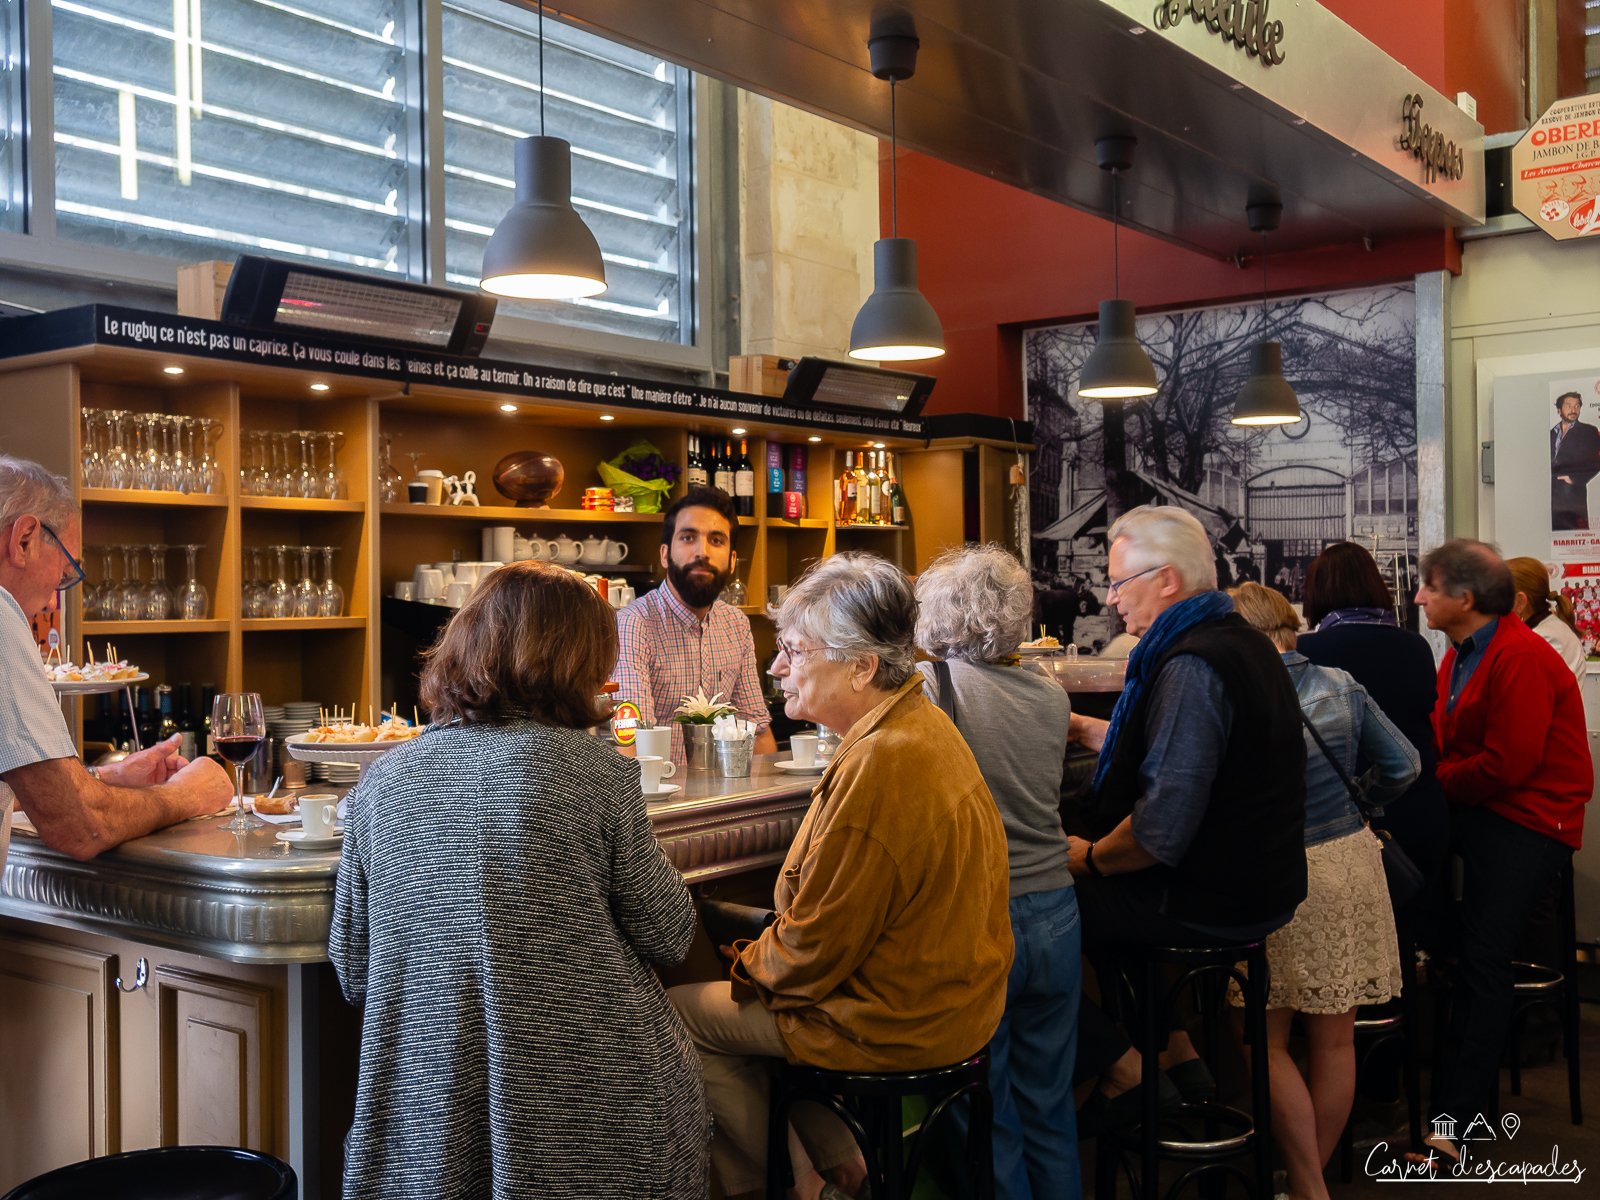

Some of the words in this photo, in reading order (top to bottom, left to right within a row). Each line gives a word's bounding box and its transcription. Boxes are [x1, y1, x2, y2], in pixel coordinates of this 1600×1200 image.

[1532, 144, 1574, 162] JAMBON
[1576, 141, 1591, 152] DE
[104, 315, 119, 335] Le
[121, 320, 157, 344] rugby
[160, 326, 174, 342] ce
[177, 325, 207, 346] n'est
[209, 333, 230, 350] pas
[232, 336, 246, 351] un
[249, 338, 291, 357] caprice.
[293, 341, 306, 361] Ça
[308, 346, 332, 363] vous
[334, 350, 360, 366] coule
[362, 352, 385, 369] dans
[386, 355, 401, 371] les
[404, 358, 432, 375] eines
[433, 361, 445, 376] et
[446, 364, 457, 380] ça
[459, 365, 479, 381] colle
[480, 369, 491, 382] au
[492, 368, 522, 386] terroir.
[523, 372, 533, 387] On
[534, 377, 540, 388] a
[541, 375, 565, 391] raison
[566, 378, 576, 392] de
[577, 379, 592, 394] dire
[593, 383, 606, 397] que
[607, 382, 626, 398] c'est
[707, 395, 719, 409] n'ai
[719, 399, 738, 412] aucun
[738, 402, 763, 415] souvenir
[763, 403, 772, 416] de
[772, 406, 796, 419] victoires
[797, 409, 804, 419] ou
[805, 409, 812, 420] de
